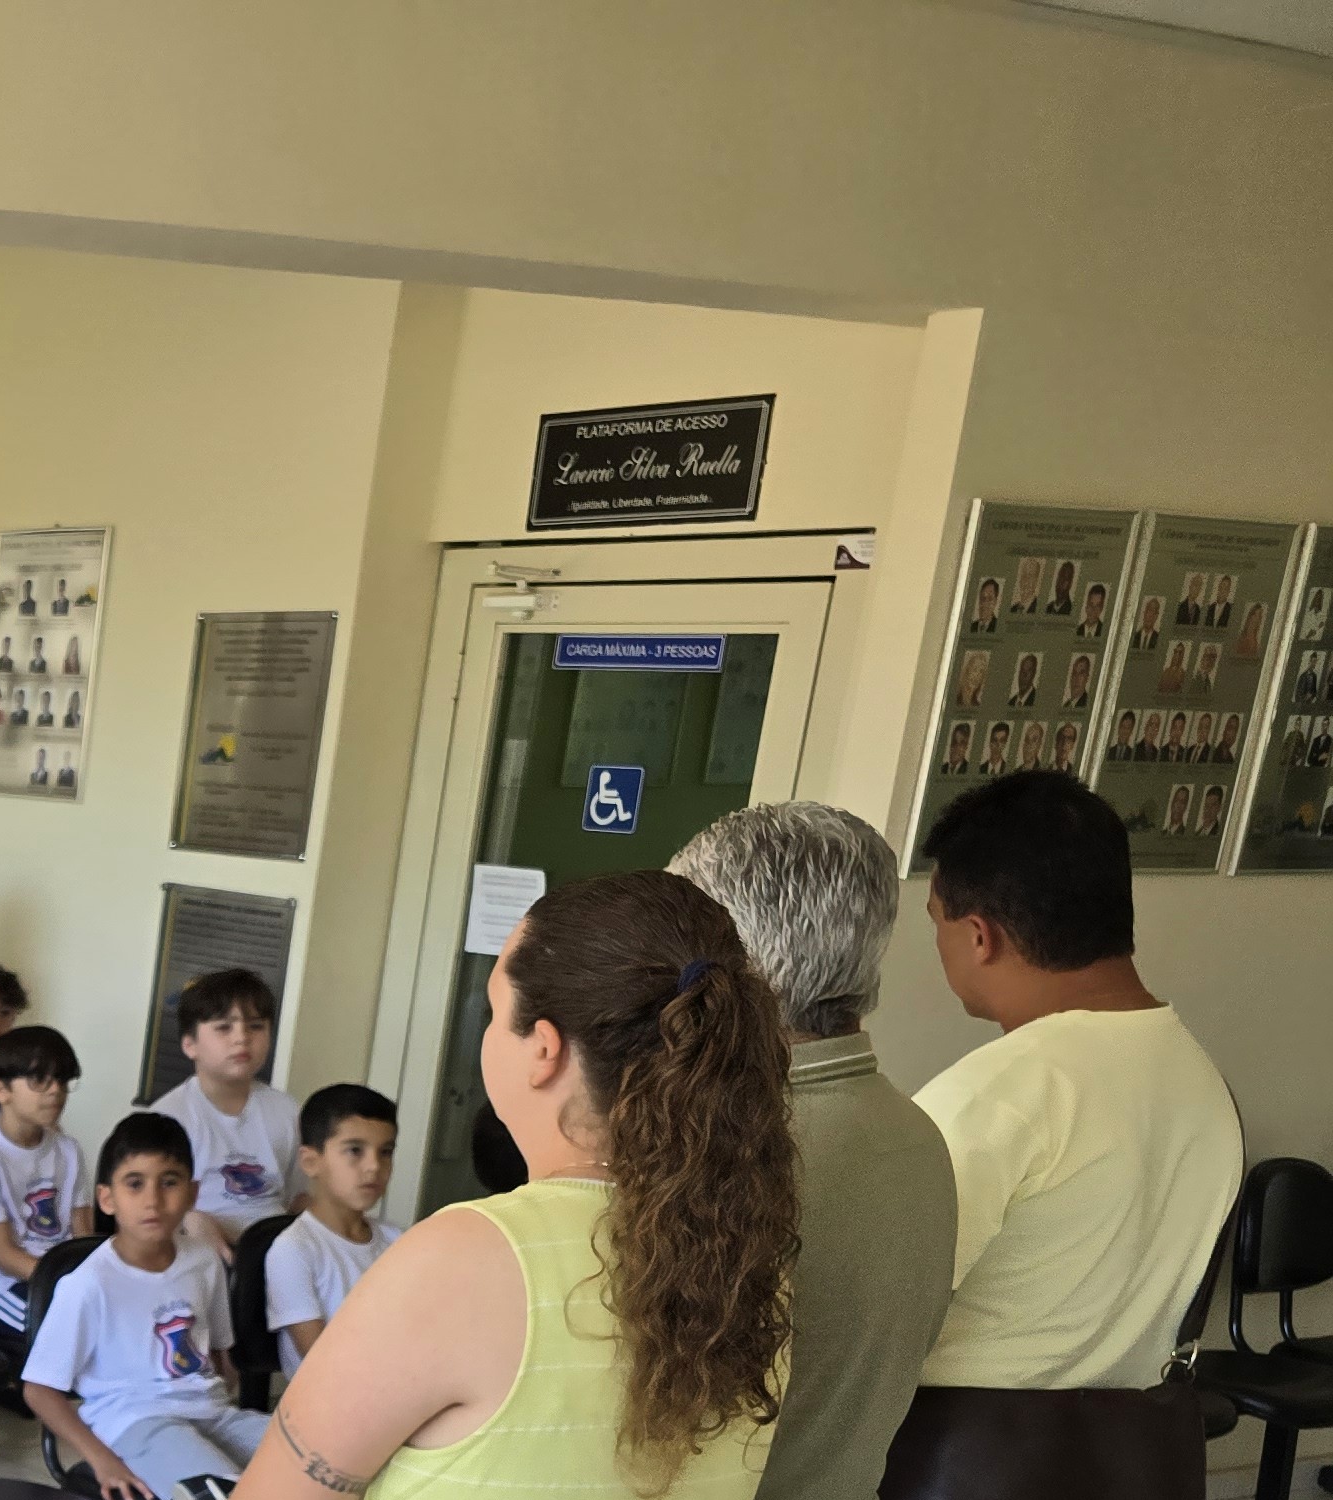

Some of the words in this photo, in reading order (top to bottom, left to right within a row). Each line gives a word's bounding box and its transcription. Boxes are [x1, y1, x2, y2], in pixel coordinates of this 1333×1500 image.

[576, 421, 653, 439] PLATAFORMA
[655, 419, 673, 433] DE
[675, 414, 729, 432] ACESSO
[619, 445, 671, 482] Silva
[675, 442, 742, 478] Ruella
[566, 643, 603, 657] CARGA
[604, 642, 647, 657] MÁXIMA
[654, 645, 662, 658] 3
[663, 644, 717, 659] PESSOAS
